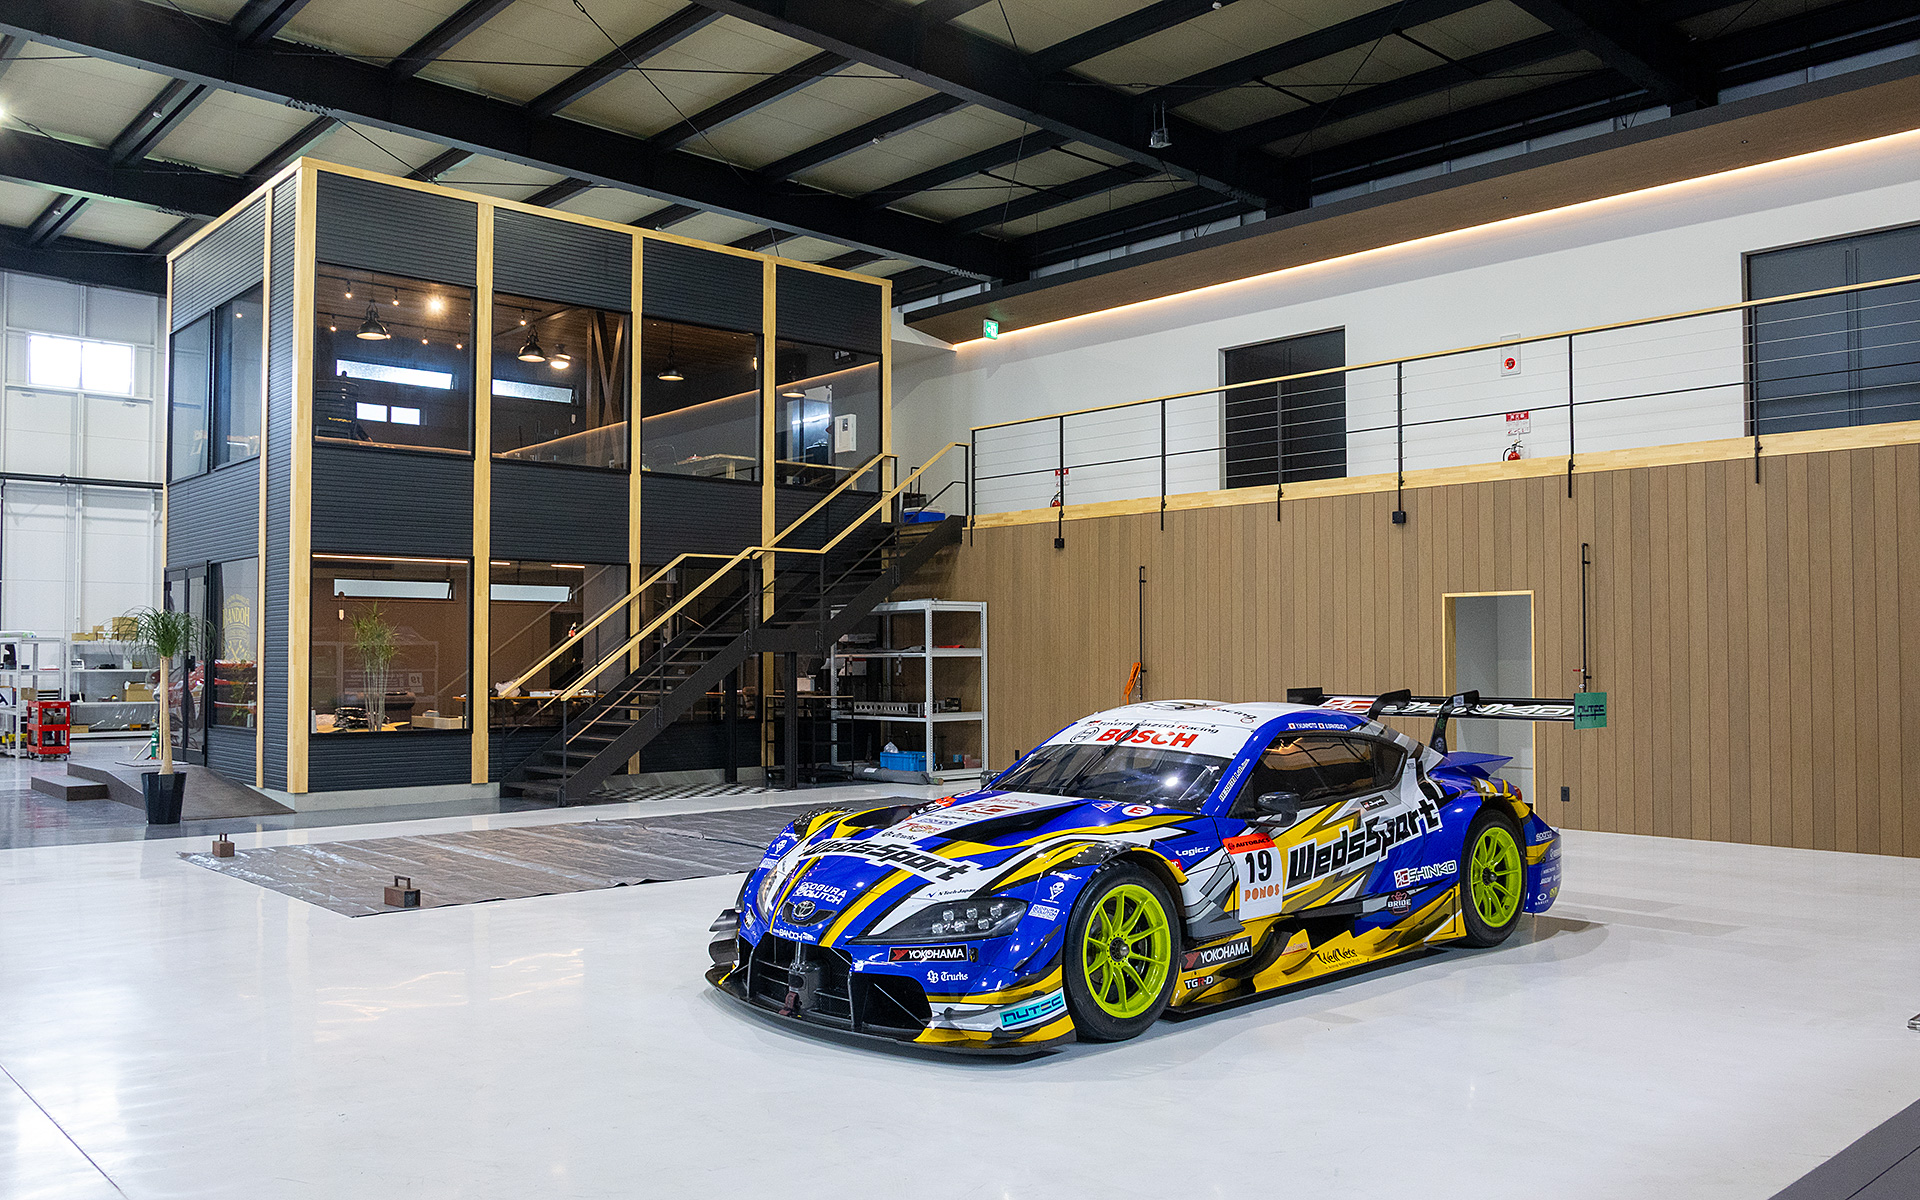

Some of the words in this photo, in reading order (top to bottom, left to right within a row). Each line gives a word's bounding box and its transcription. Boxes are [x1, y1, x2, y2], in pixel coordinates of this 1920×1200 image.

[1096, 728, 1199, 748] BOSCH
[1175, 846, 1211, 857] Logics
[1286, 798, 1441, 890] WedsSport
[1244, 849, 1272, 884] 19
[1409, 860, 1457, 881] SHINKO
[1244, 883, 1280, 902] PONOS
[1387, 898, 1412, 908] BRIDE
[908, 948, 965, 960] YOKOHAMA
[1200, 941, 1250, 964] YOKOHAMA
[940, 971, 969, 981] Trucks
[1185, 975, 1214, 990] TGR-D
